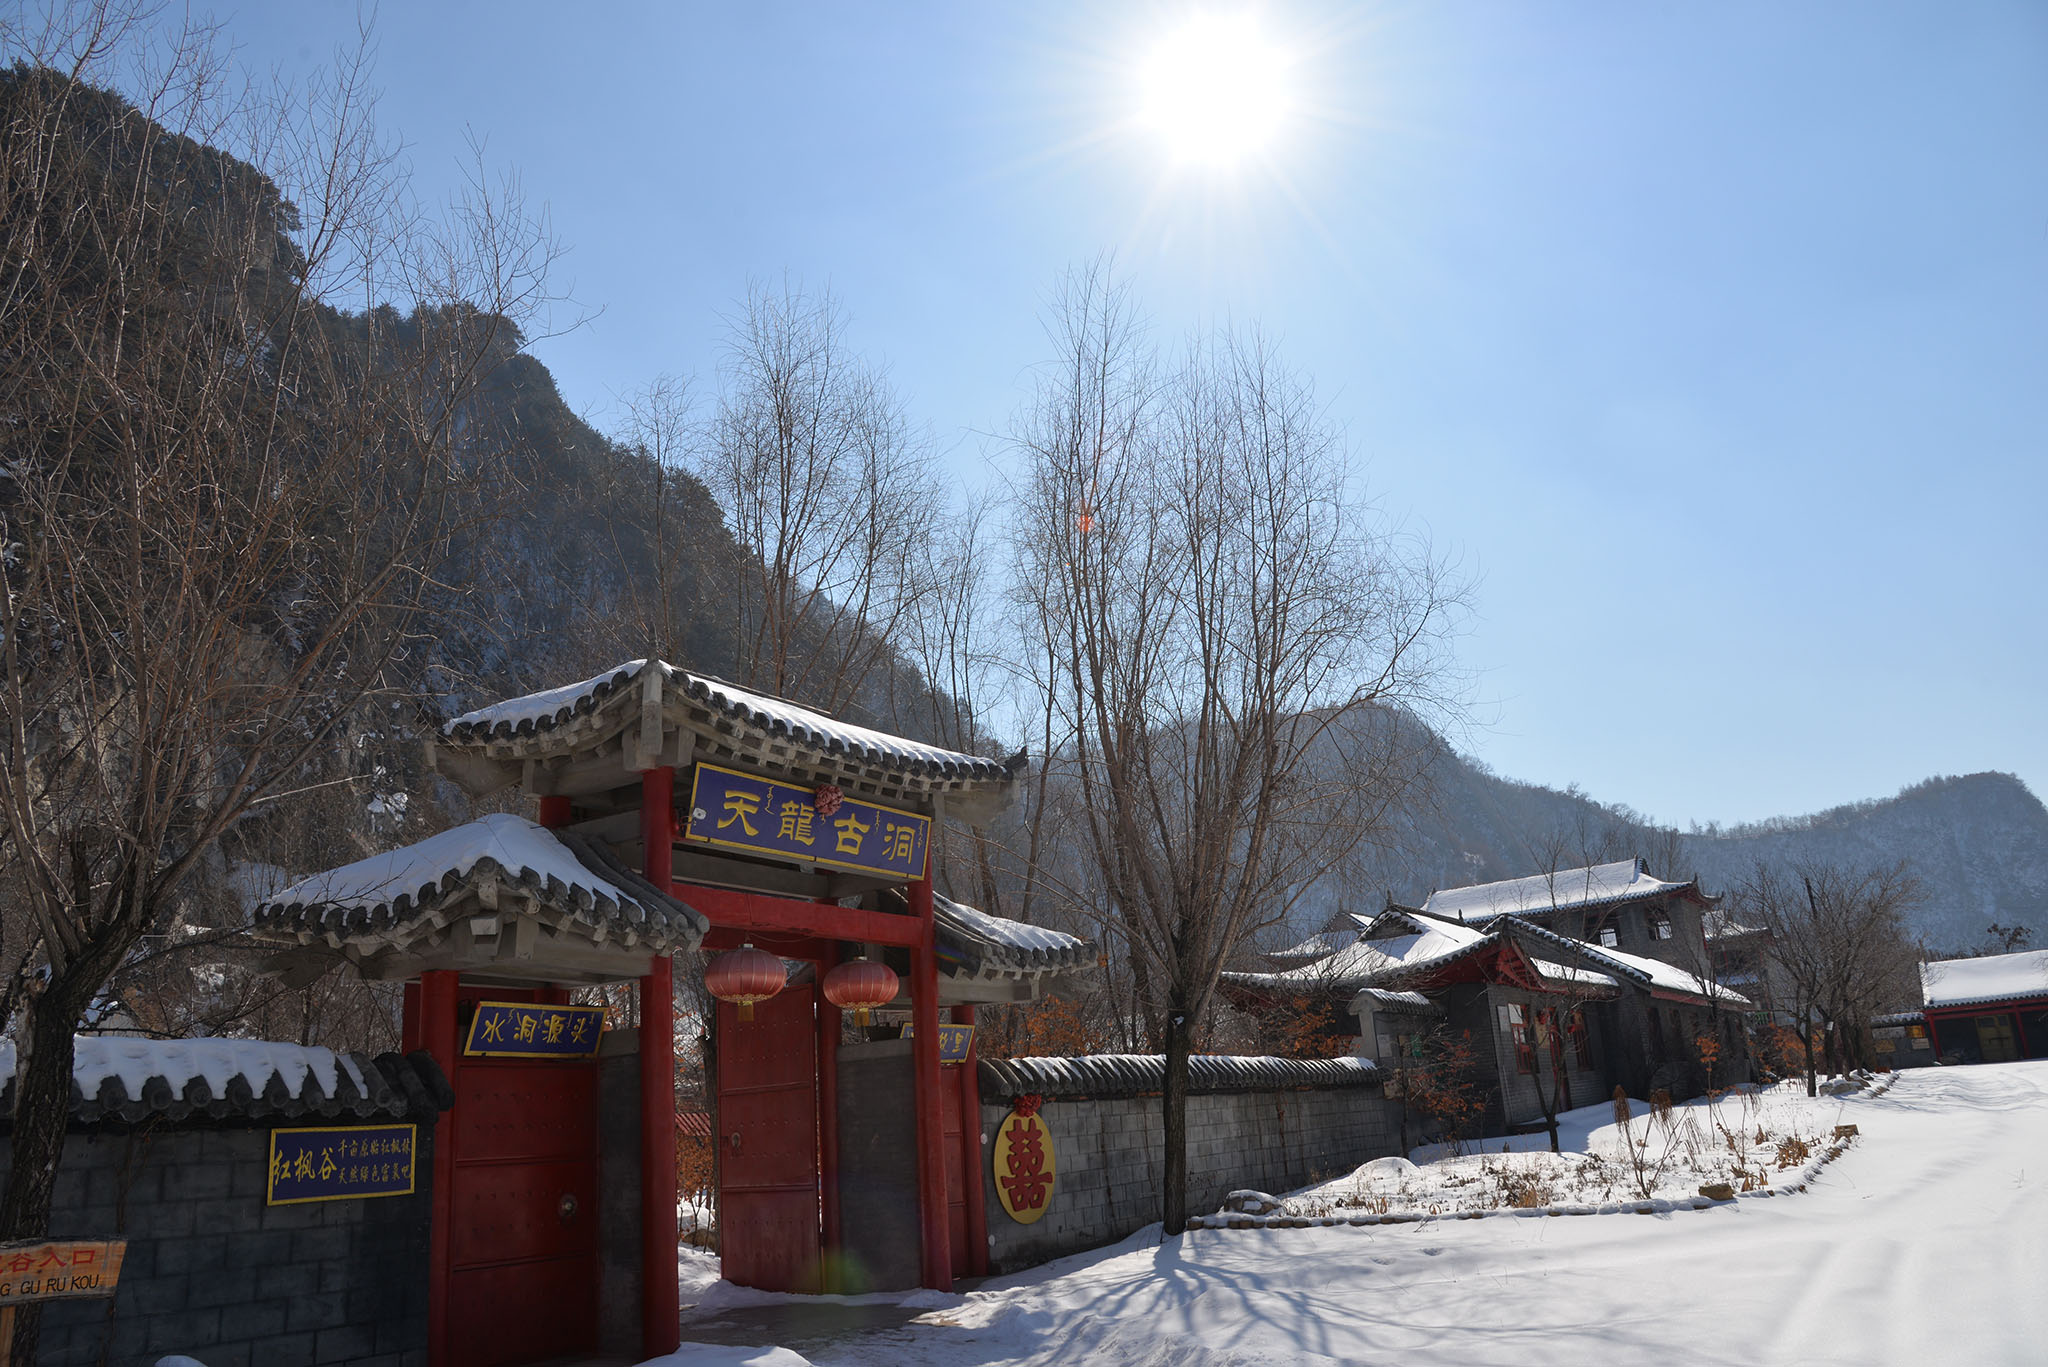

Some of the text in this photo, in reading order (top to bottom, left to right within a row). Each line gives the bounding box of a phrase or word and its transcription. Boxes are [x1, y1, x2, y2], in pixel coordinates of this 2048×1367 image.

[717, 790, 916, 865] 天龍古洞
[273, 1147, 337, 1186] 红枫谷
[0, 1249, 96, 1274] 谷入口
[20, 1280, 40, 1295] GU
[46, 1277, 66, 1293] RU
[71, 1274, 100, 1291] KOU
